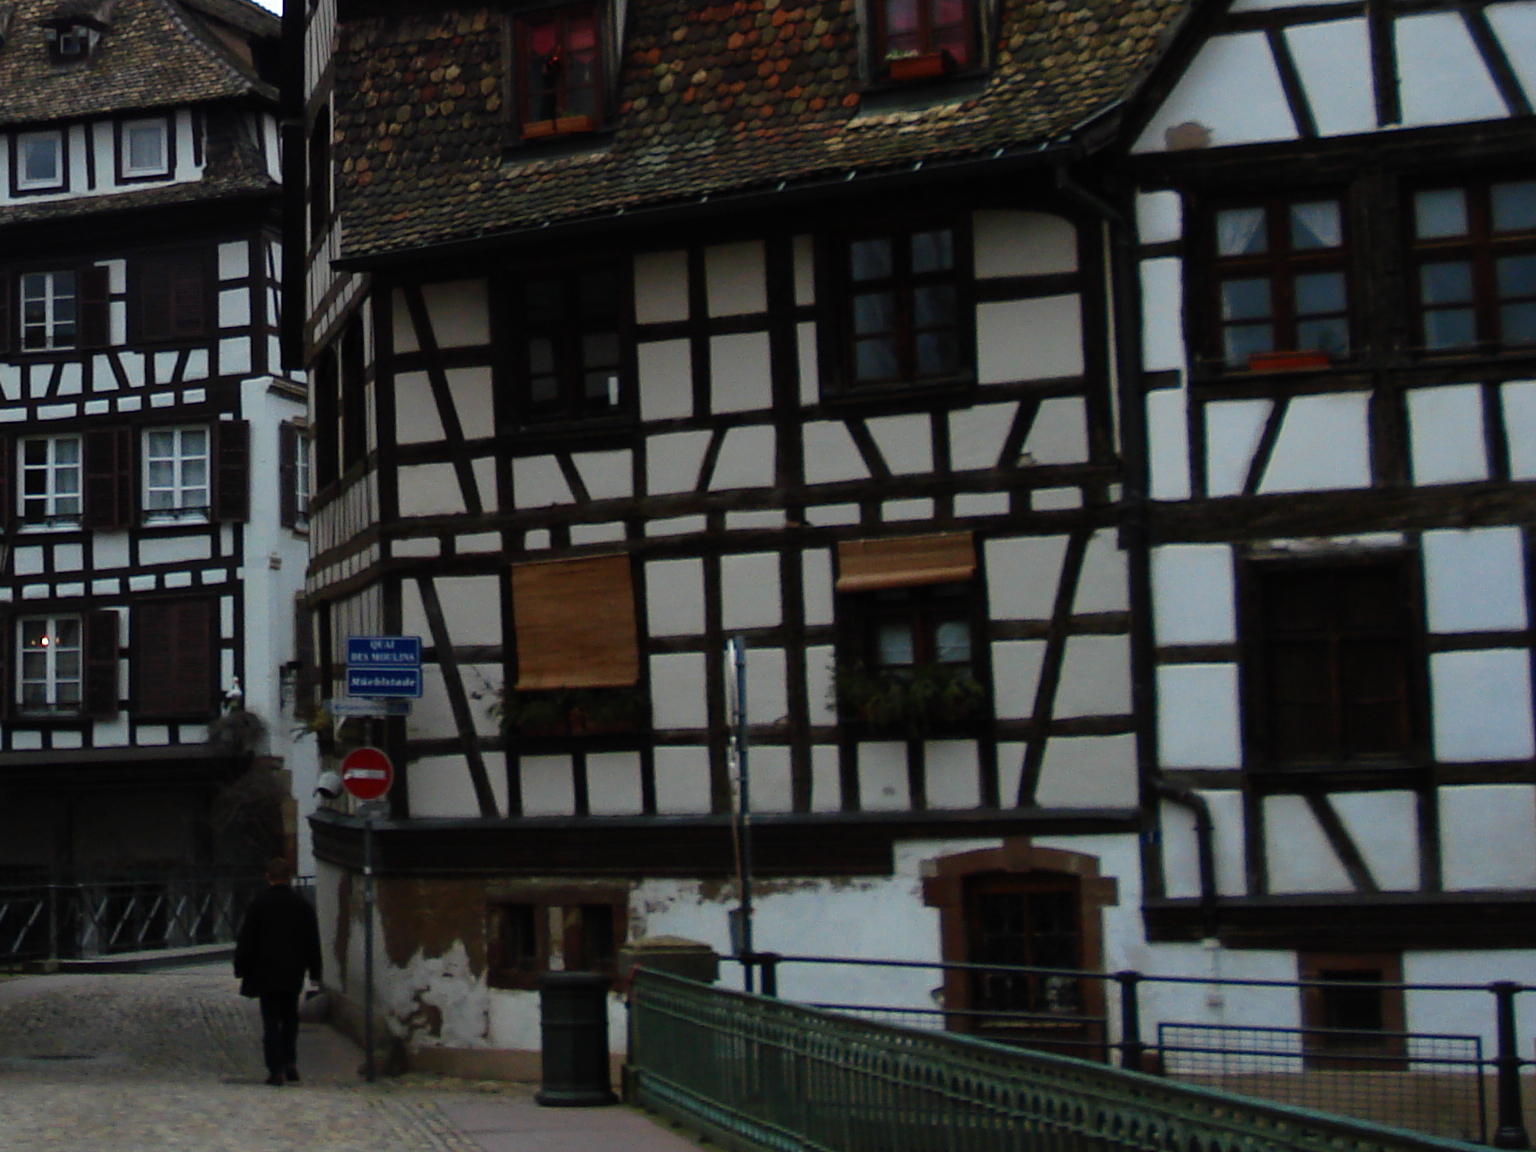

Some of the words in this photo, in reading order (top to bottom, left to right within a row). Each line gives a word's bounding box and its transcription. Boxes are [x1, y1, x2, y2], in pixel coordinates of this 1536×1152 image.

[370, 640, 395, 650] QUAI
[351, 652, 369, 662] DES
[371, 652, 415, 662] MOULINS
